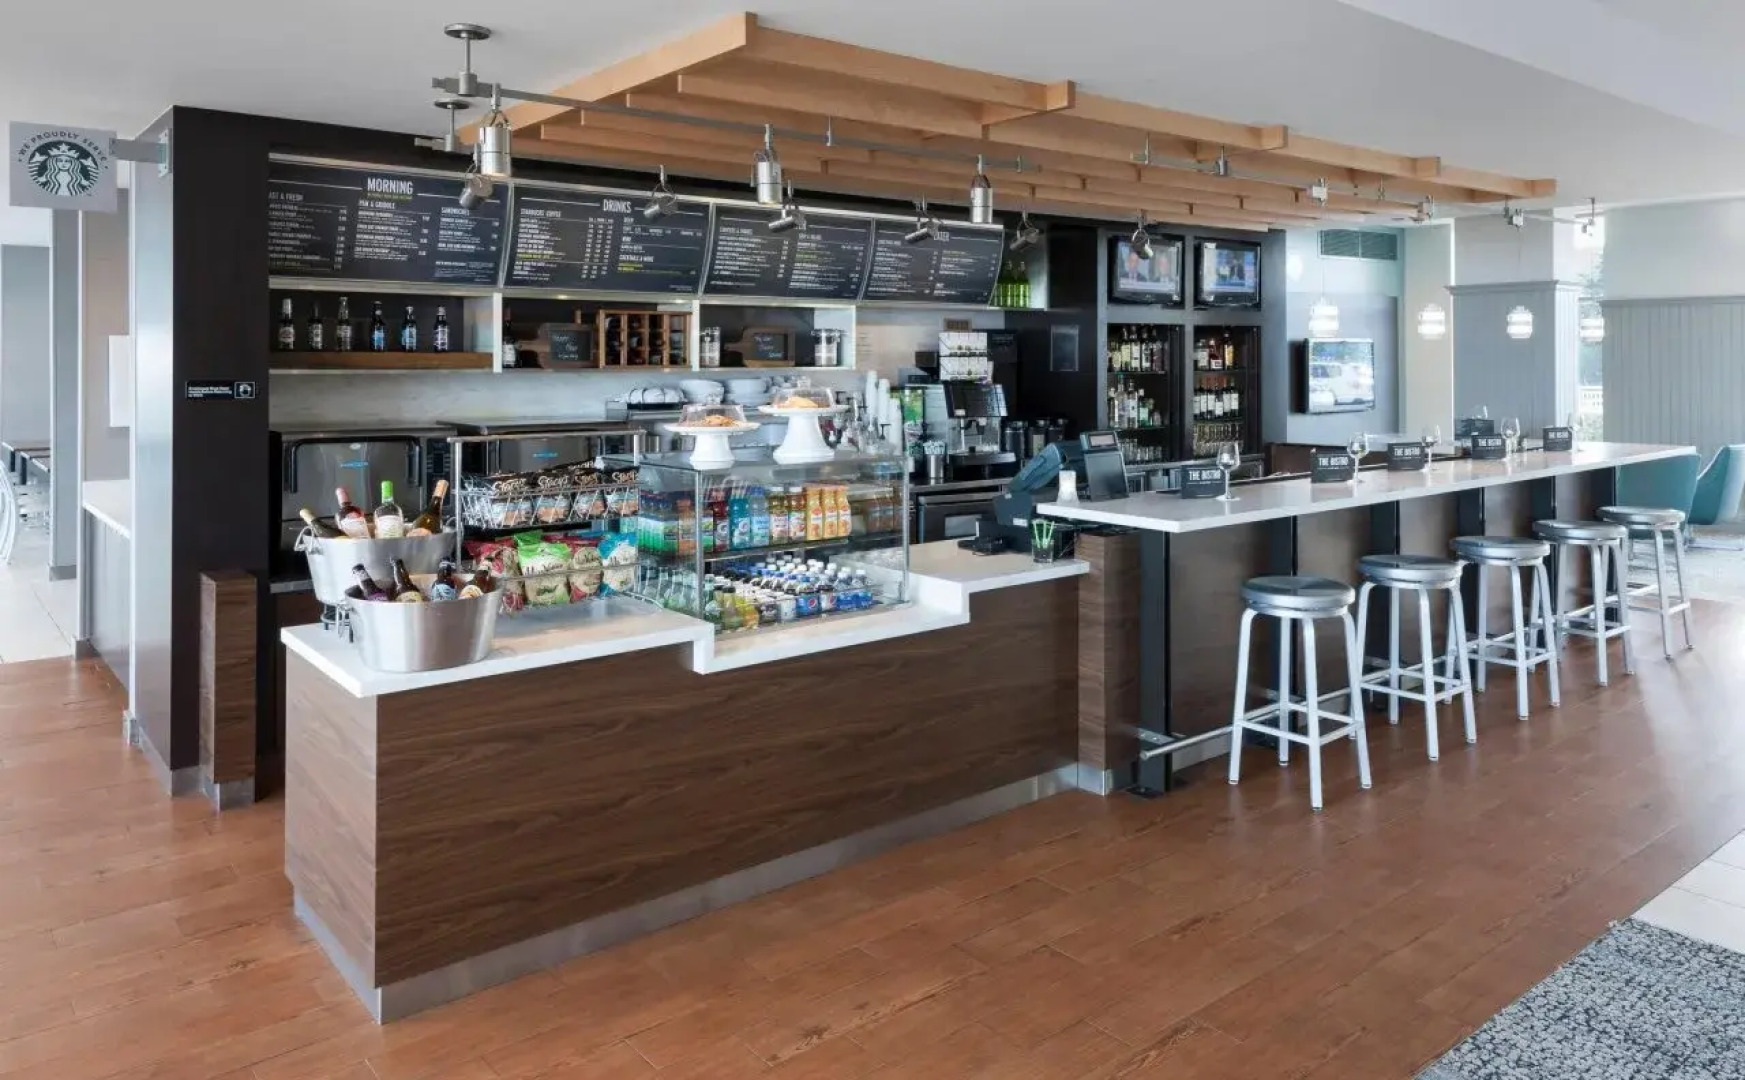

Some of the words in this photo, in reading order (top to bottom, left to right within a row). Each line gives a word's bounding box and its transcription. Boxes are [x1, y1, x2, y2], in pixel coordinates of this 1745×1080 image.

[31, 131, 79, 143] PROUDLY
[367, 177, 413, 194] MORNING
[603, 199, 632, 213] DRINKS
[1394, 448, 1404, 456] THE
[1318, 457, 1329, 466] THE
[1188, 470, 1200, 481] THE
